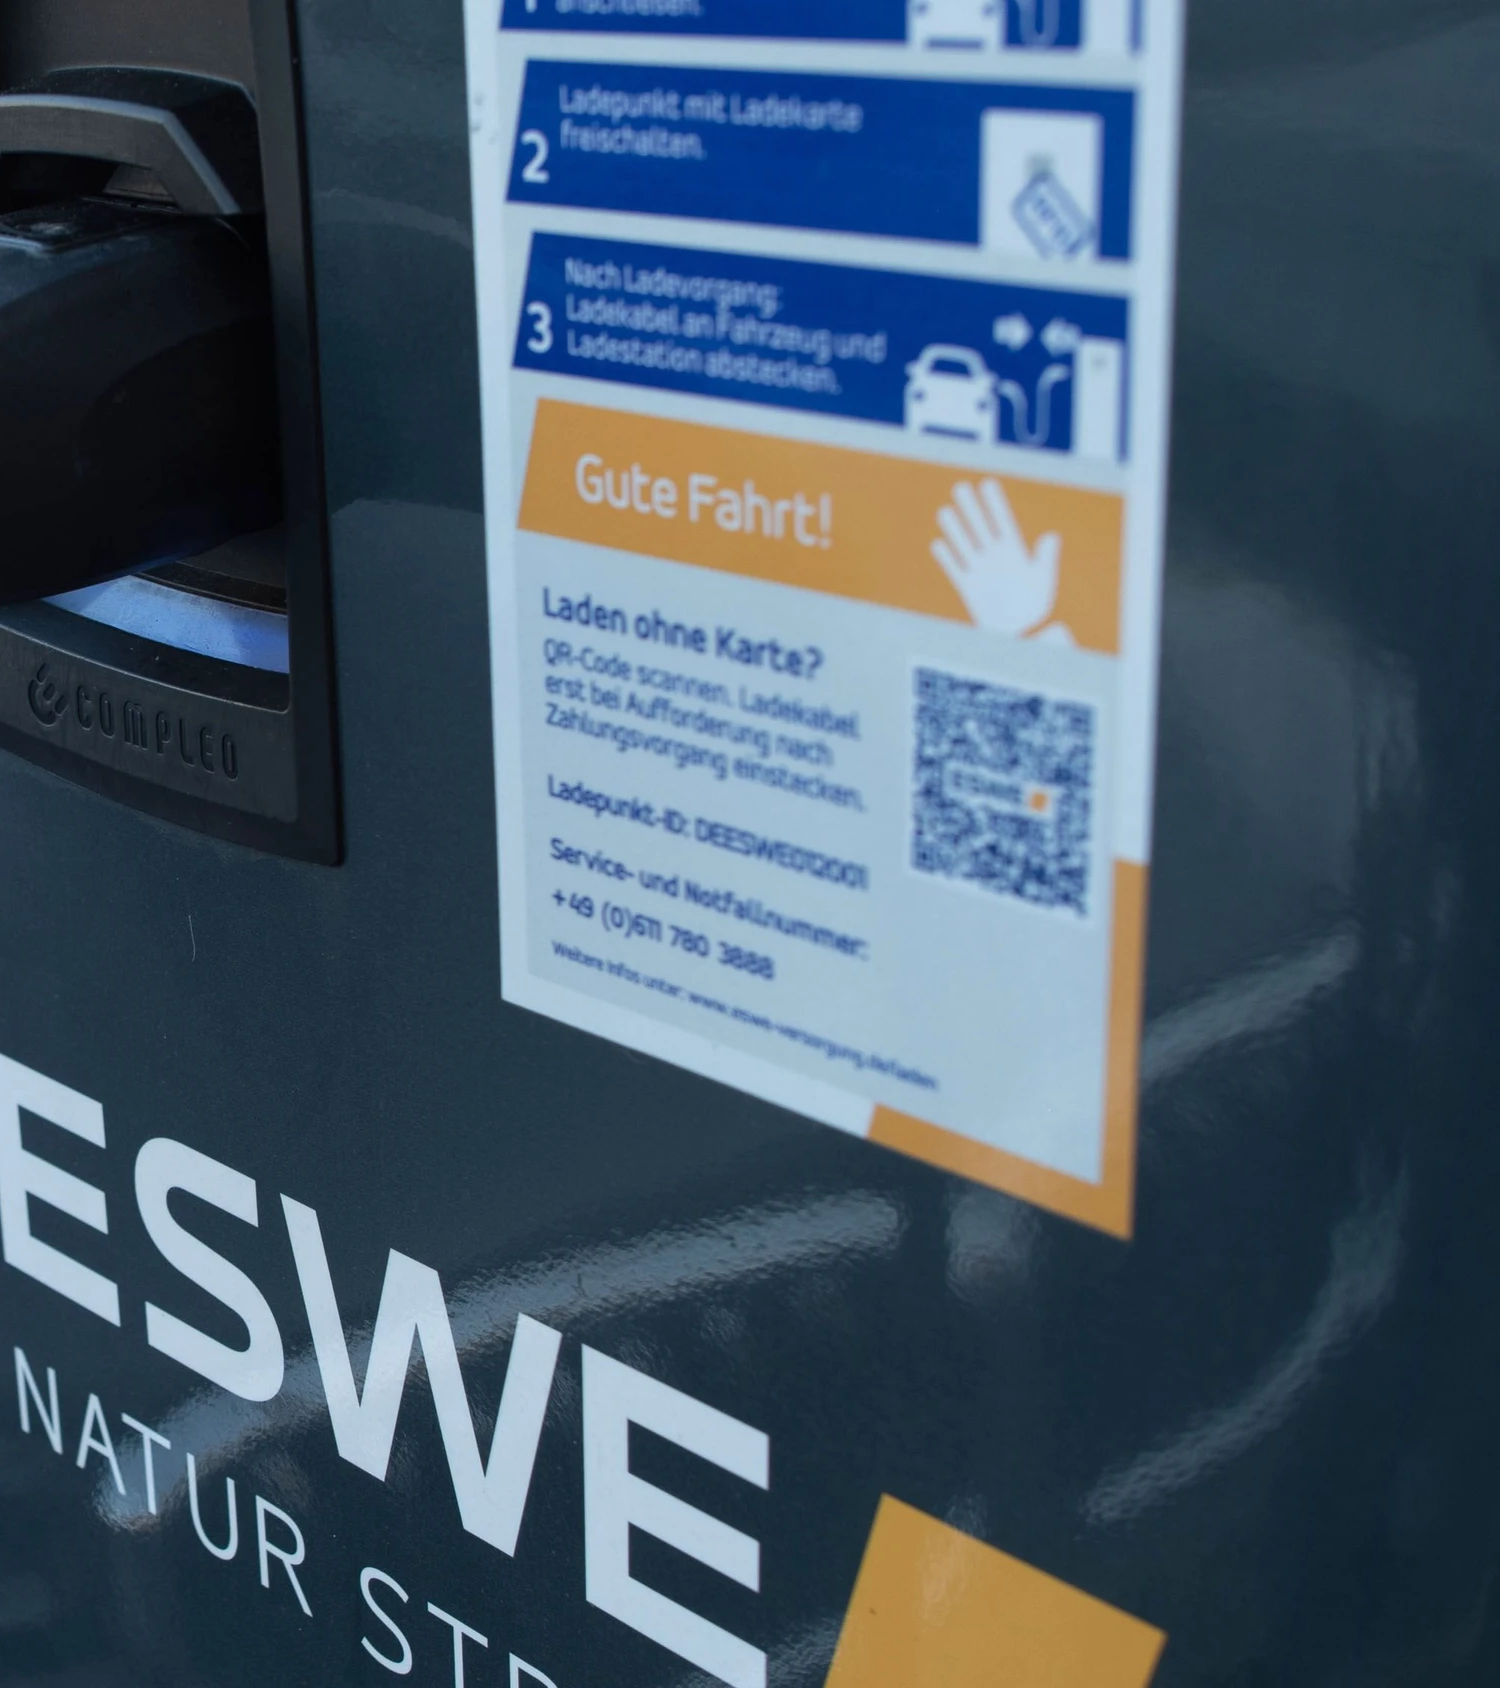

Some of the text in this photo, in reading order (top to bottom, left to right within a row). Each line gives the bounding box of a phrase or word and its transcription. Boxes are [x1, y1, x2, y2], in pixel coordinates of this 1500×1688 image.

[559, 83, 864, 133] Ladepunkt mit Ladekarte
[560, 118, 708, 161] freischalten.
[520, 129, 550, 184] 2
[565, 257, 784, 319] Nach Ladevorgang:
[526, 301, 554, 354] 3
[565, 293, 888, 366] Ladekabel an Fahrzeug und
[567, 328, 842, 396] Ladestation abstecken.
[575, 453, 832, 550] Gute Fahrt!
[543, 586, 825, 680] Laden ohne Karte?
[544, 637, 862, 742] QR-Code scannen. Ladekabel
[545, 675, 834, 768] erst bei Aufforderung nach
[74, 683, 240, 782] COMPLEO
[546, 702, 868, 814] Zahlungsvorgang einstecken.
[548, 774, 691, 838] Ladepunkt-ID:
[550, 837, 871, 961] Service- und Notfallnummer:
[601, 900, 663, 940] (0)611
[668, 924, 709, 958] 780
[551, 940, 604, 973] Weitere
[13, 1346, 312, 1618] NATUR
